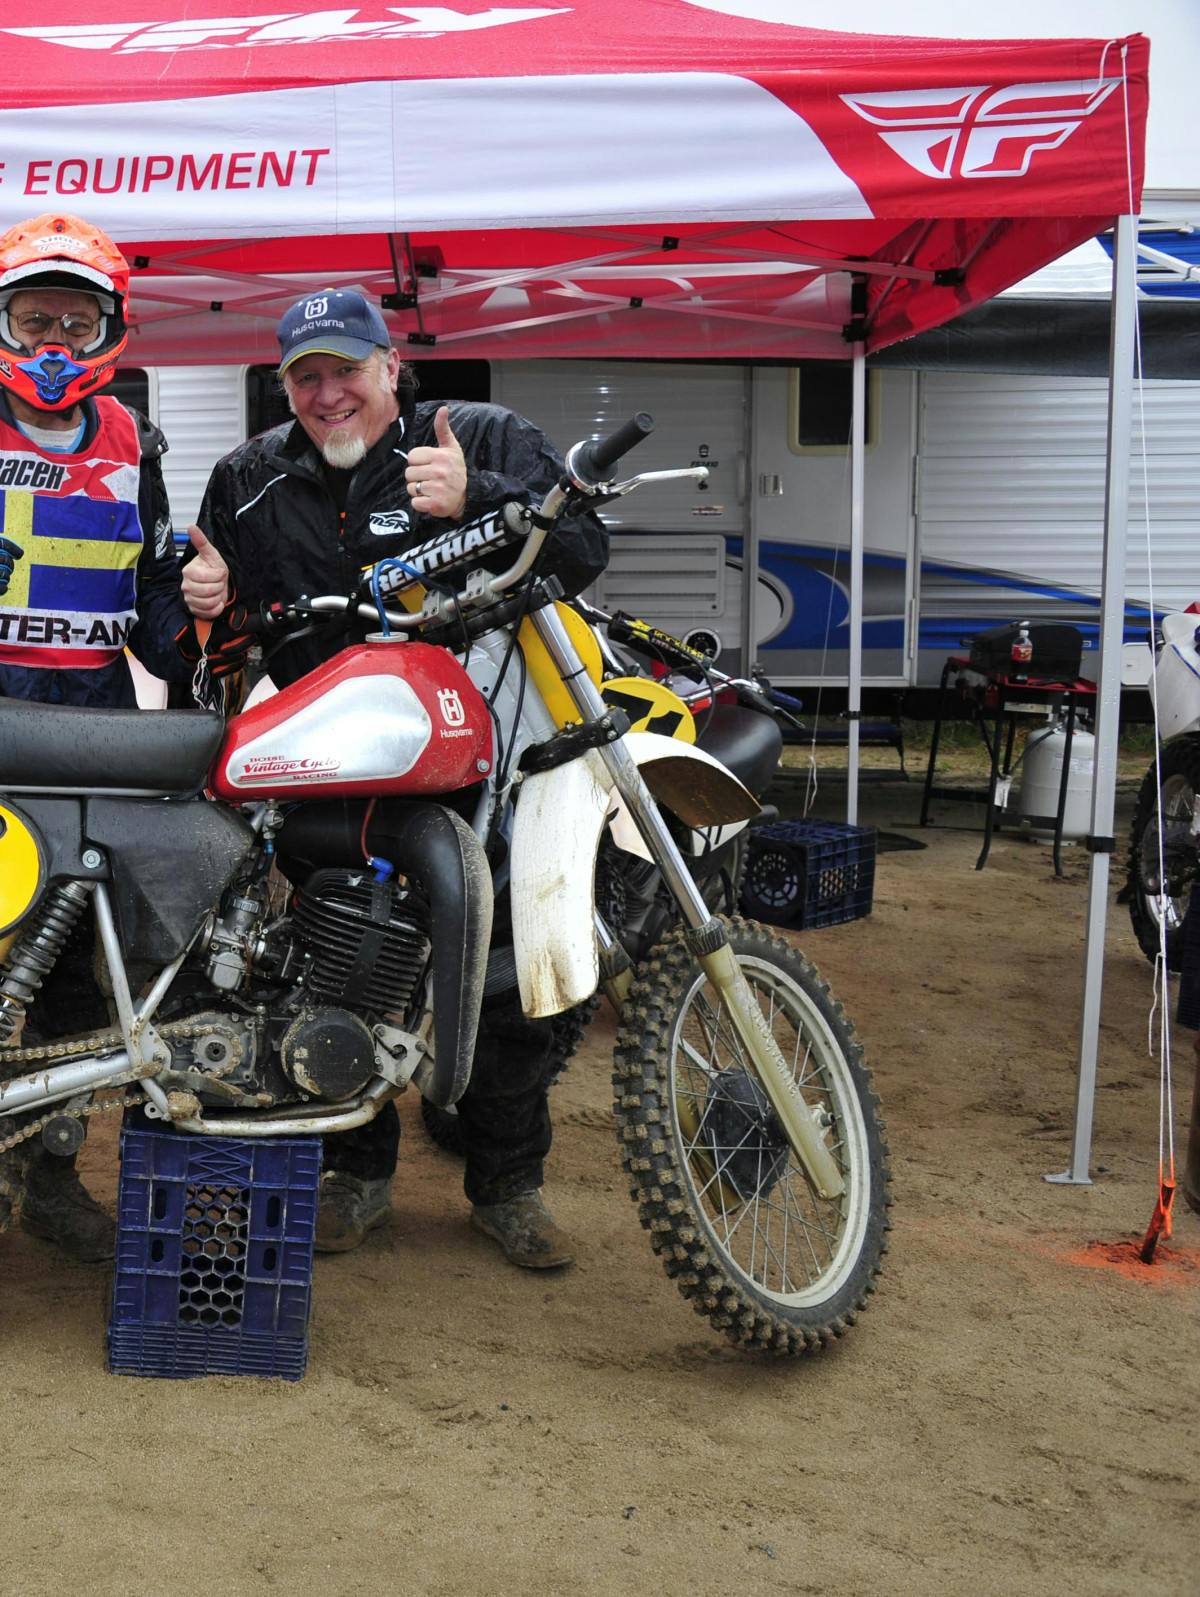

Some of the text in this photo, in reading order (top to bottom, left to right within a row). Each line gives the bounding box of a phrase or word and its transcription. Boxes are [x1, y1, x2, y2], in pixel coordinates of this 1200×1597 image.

[30, 7, 576, 49] FLY
[23, 149, 330, 195] EQUIPMENT
[292, 319, 344, 338] Husqvarna
[369, 519, 504, 594] RENTHAL
[440, 728, 473, 739] Husqvarna
[243, 761, 298, 774] Vintage
[292, 772, 337, 780] RACING
